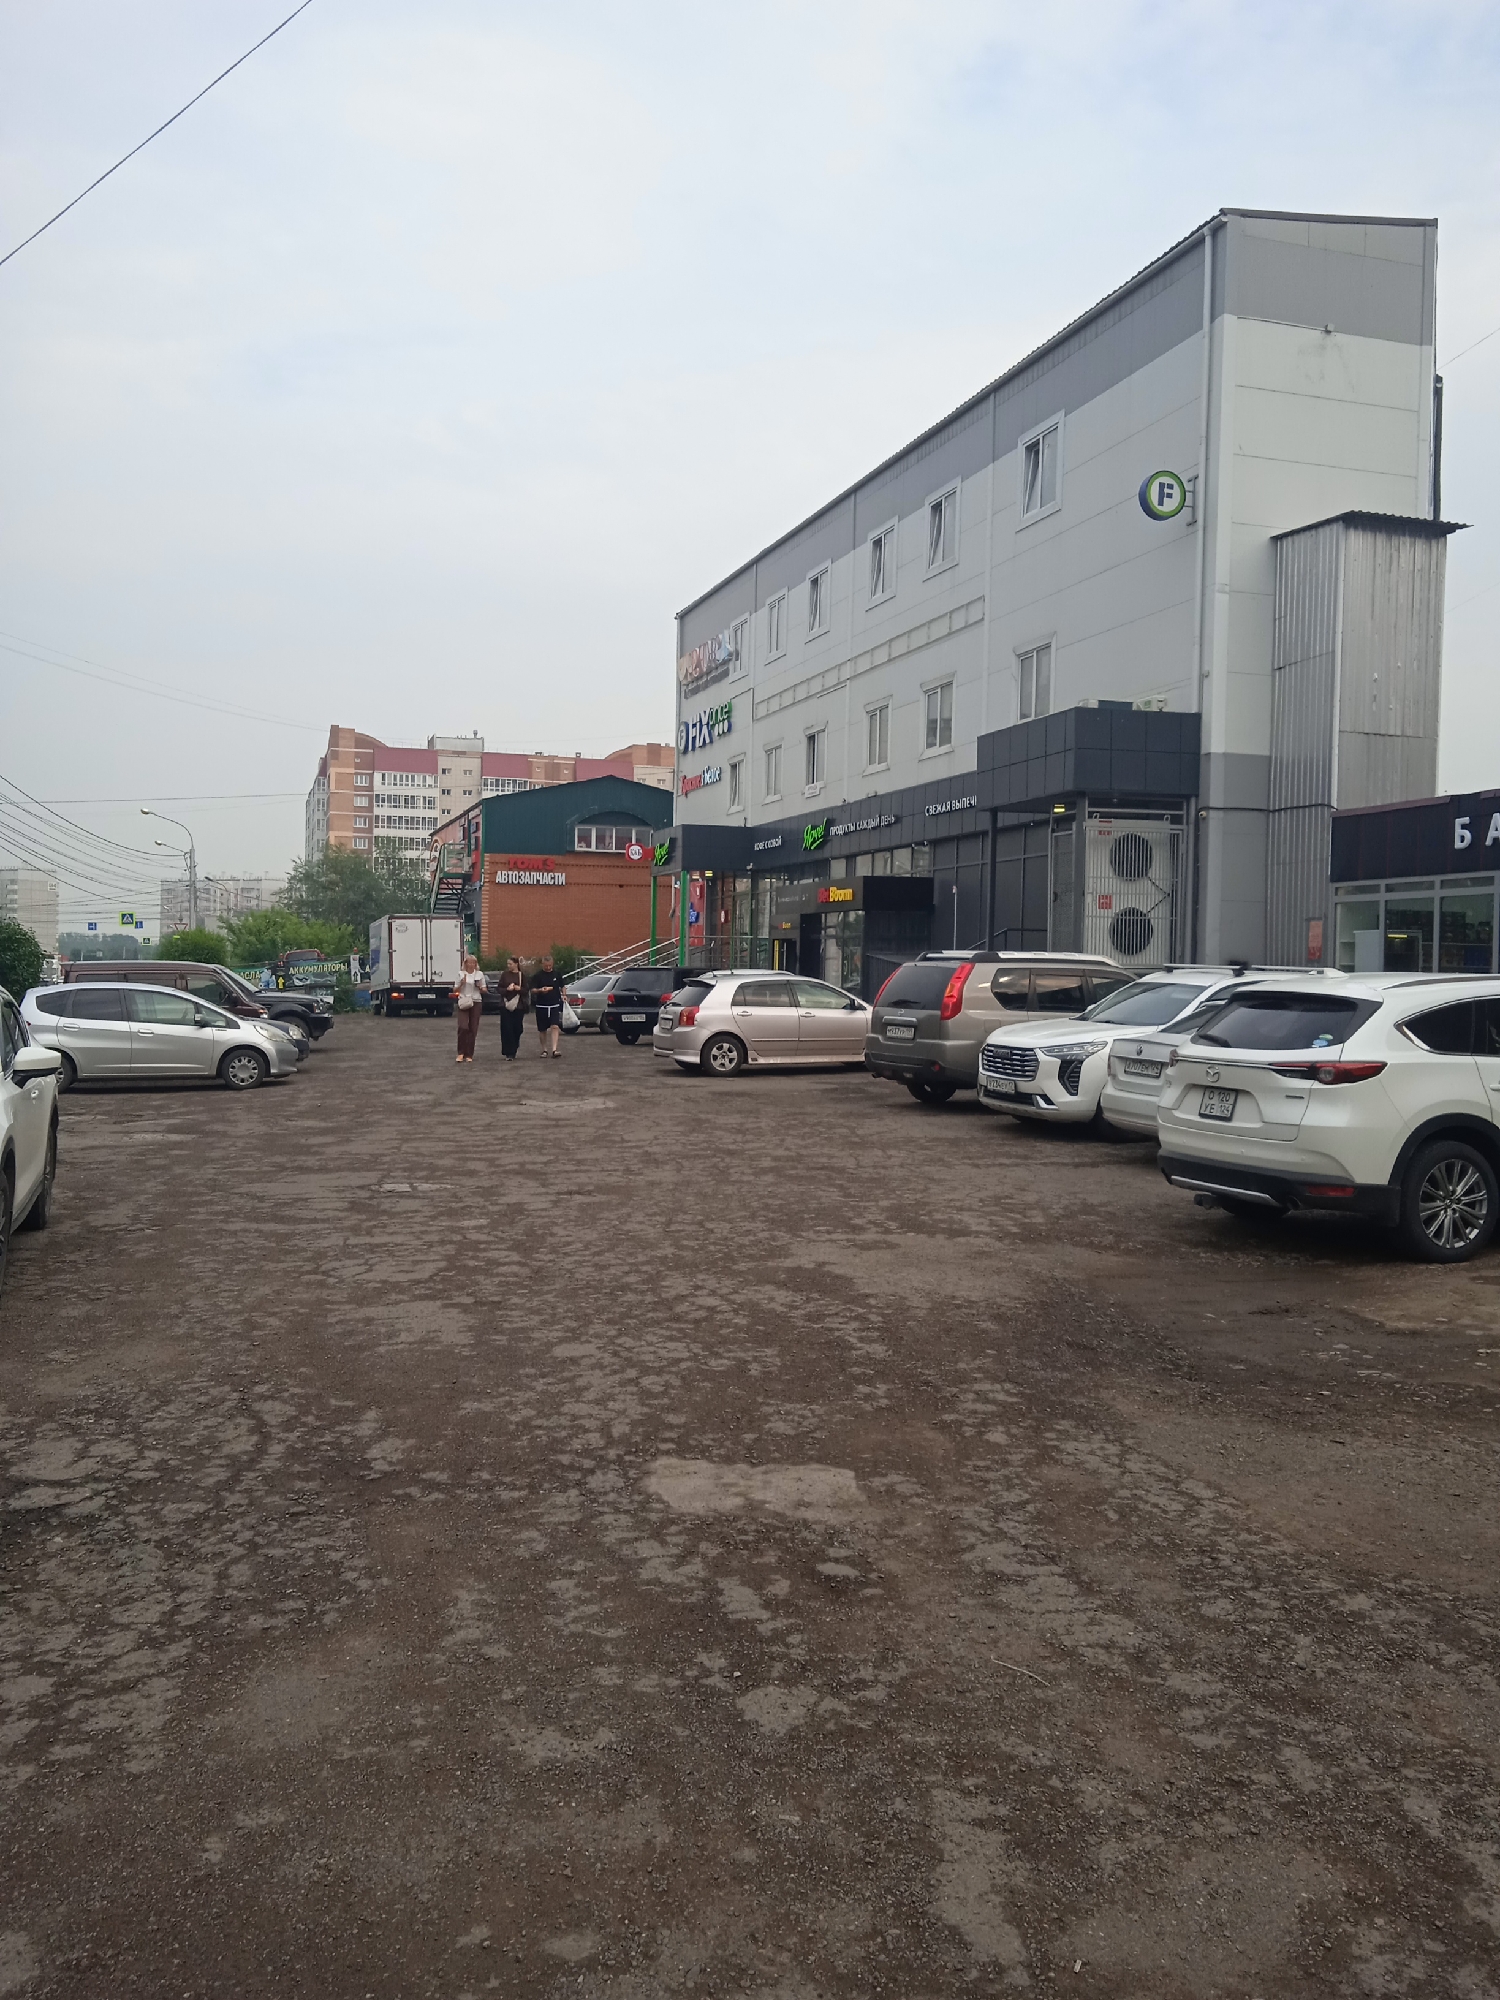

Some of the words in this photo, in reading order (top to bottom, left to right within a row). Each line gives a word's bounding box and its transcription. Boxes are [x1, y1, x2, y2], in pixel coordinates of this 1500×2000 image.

[1157, 481, 1174, 507] F
[924, 800, 951, 817] СВЕЖАЯ
[829, 822, 856, 836] ПРОДУКТЫ
[856, 815, 880, 831] КАЖДЫЙ
[880, 813, 895, 828] ДЕНЬ
[496, 870, 566, 886] АВТОЗАПЧАСТИ
[288, 962, 348, 976] АККУМУЛЯТОРЫ
[1218, 1091, 1231, 1103] 120
